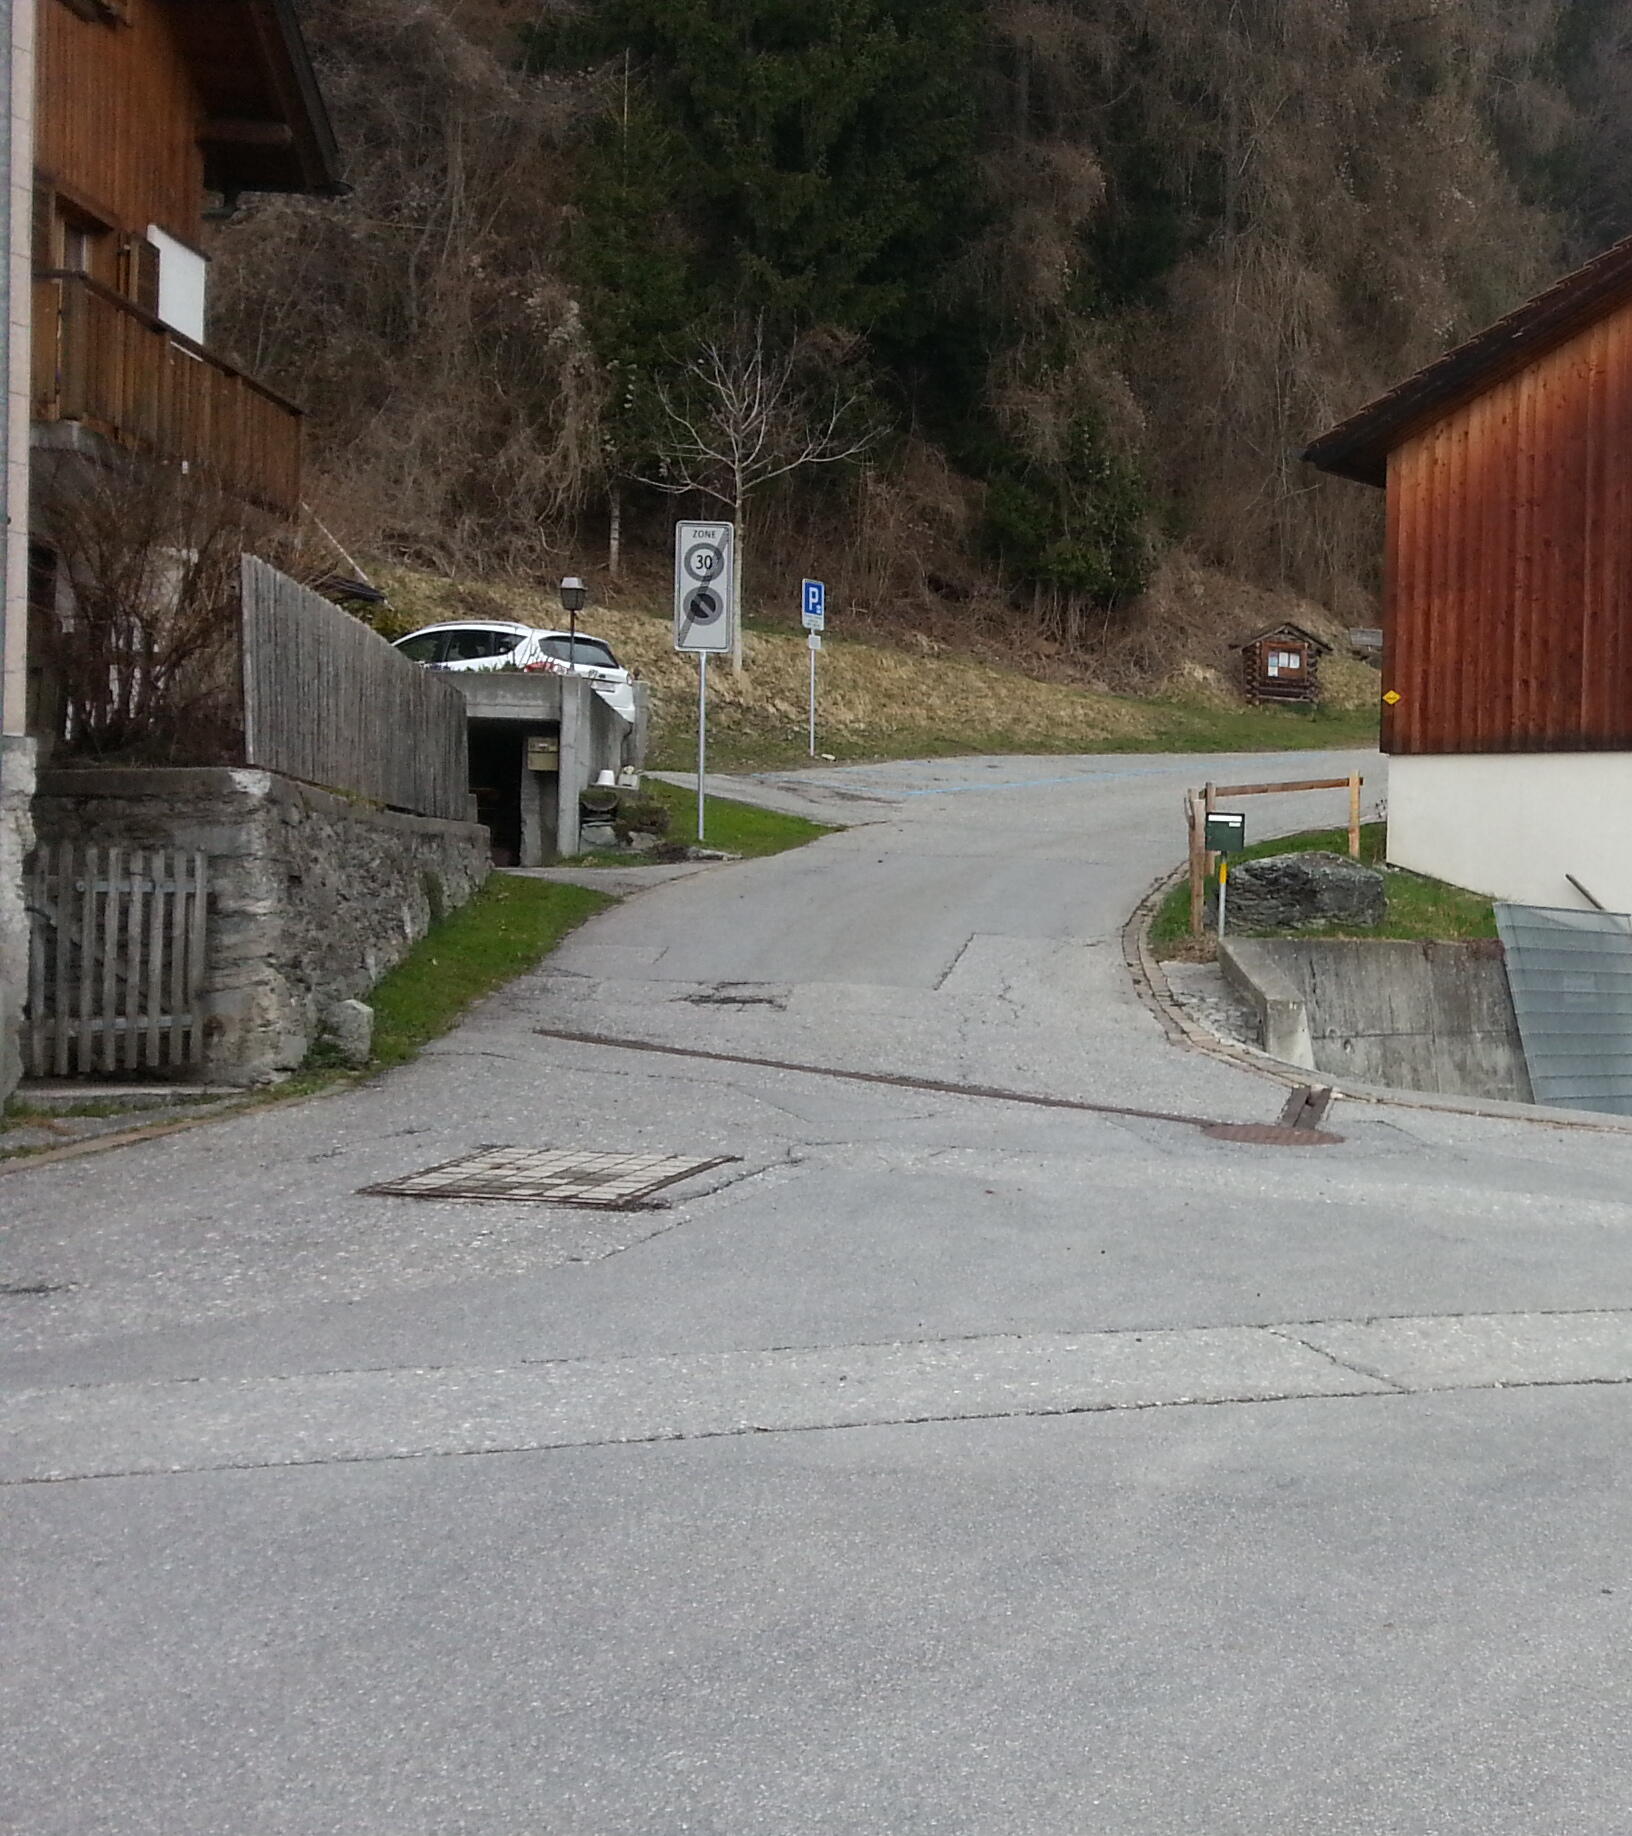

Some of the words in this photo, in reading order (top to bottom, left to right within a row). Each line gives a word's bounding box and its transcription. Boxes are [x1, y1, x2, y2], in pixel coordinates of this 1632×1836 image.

[692, 530, 716, 538] ZONE
[695, 554, 713, 570] 30
[808, 586, 819, 611] P
